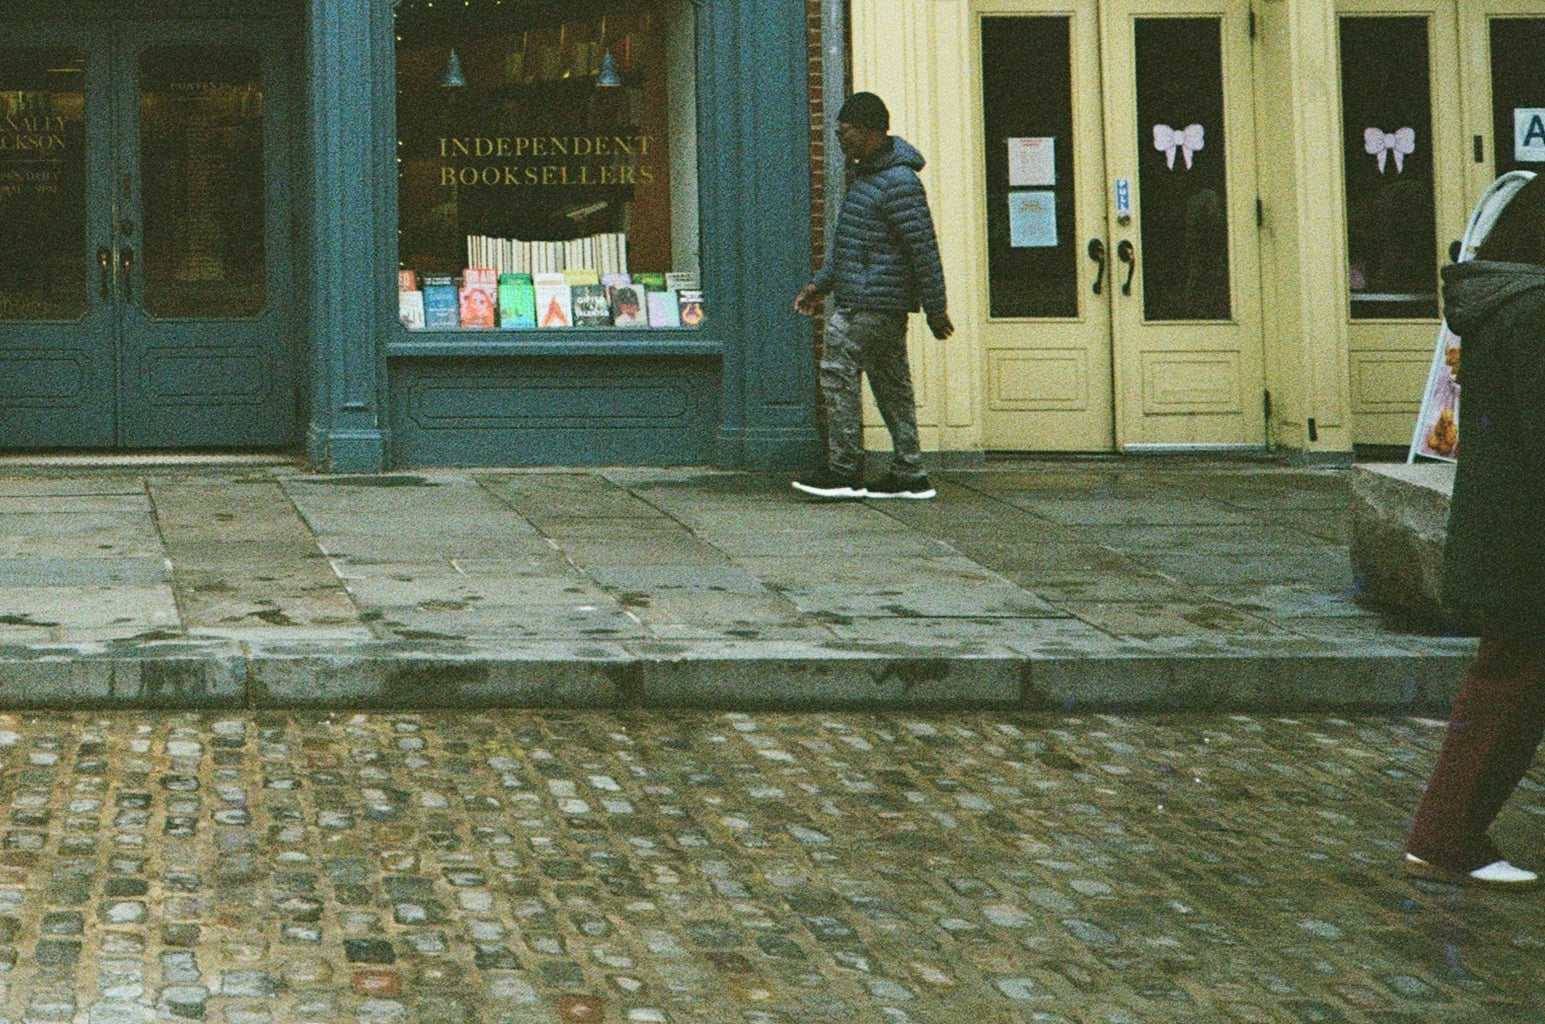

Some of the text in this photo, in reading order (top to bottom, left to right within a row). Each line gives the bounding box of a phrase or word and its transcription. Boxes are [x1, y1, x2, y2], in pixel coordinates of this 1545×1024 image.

[1523, 114, 1545, 147] A
[439, 134, 655, 158] INDEPENDENT
[439, 165, 655, 187] BOOKSELLERS
